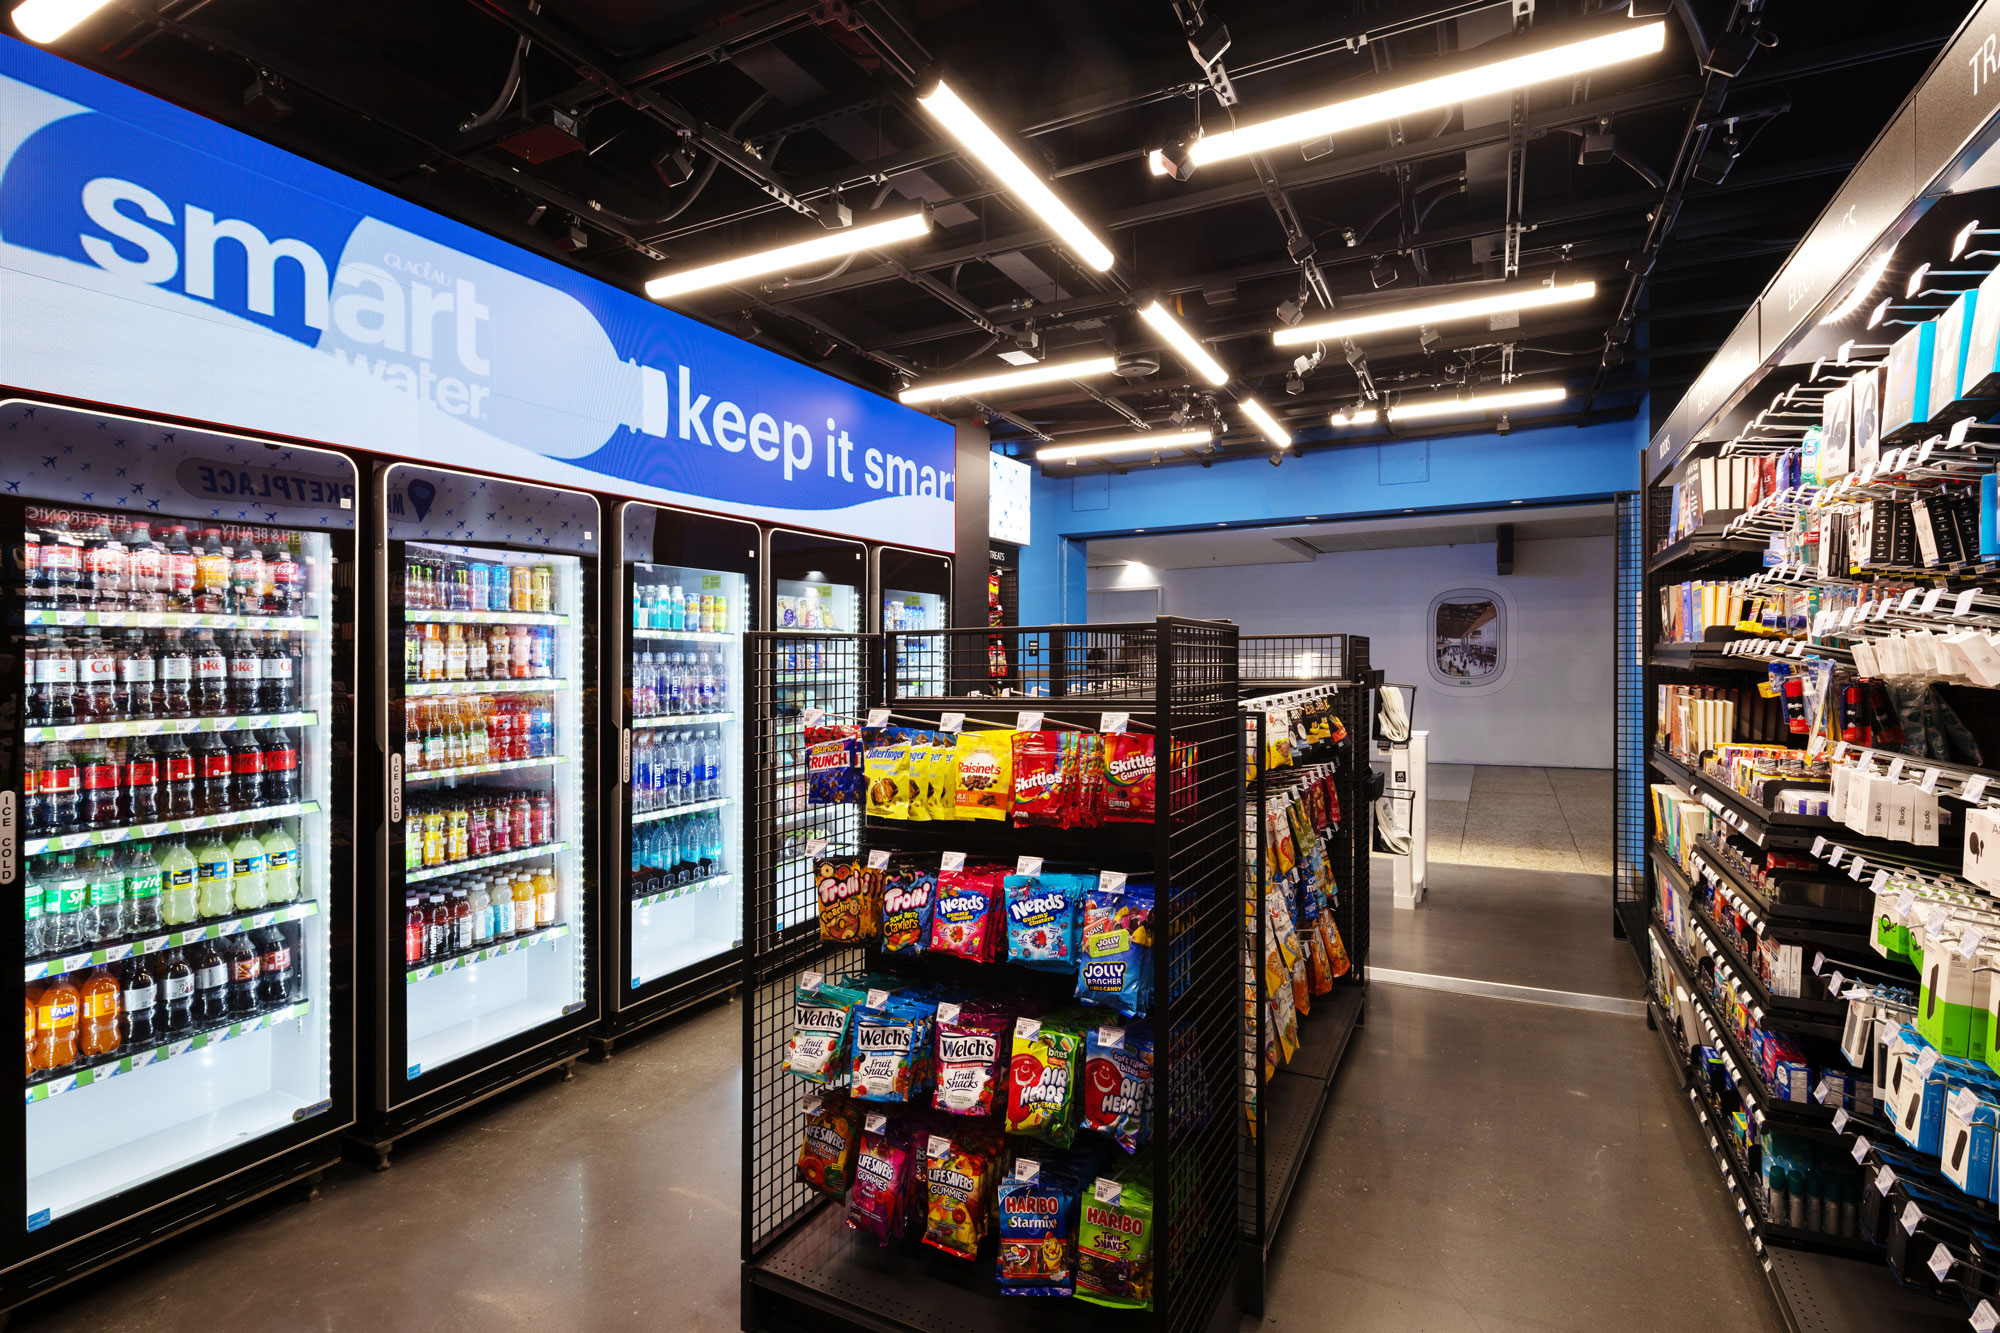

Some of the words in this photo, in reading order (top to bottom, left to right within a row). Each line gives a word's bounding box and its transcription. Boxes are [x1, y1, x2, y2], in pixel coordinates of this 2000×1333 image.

[1969, 33, 2000, 97] TR
[80, 177, 490, 377] smart
[334, 347, 490, 420] water
[679, 364, 813, 481] keep
[826, 417, 854, 482] it
[864, 447, 955, 503] smar
[989, 550, 1005, 561] TREATS
[813, 744, 844, 755] Buncha
[958, 761, 1001, 775] Raisinets
[1015, 771, 1063, 793] Skittles
[2, 796, 11, 827] ICE
[2, 837, 12, 880] COLD
[125, 876, 161, 893] Sprite
[819, 869, 859, 903] Trolli
[884, 882, 931, 913] Trolli
[821, 901, 850, 922] Peachie
[947, 911, 969, 919] Gummy
[1022, 912, 1048, 923] Gummy
[884, 918, 918, 936] Crawlers
[1029, 916, 1055, 926] Clusters
[1085, 924, 1103, 938] JOLLY
[1097, 936, 1120, 948] JOLLY
[1085, 964, 1124, 977] JOLLY
[797, 1010, 843, 1028] Welch's
[804, 1038, 823, 1048] Fruit
[860, 1029, 910, 1046] Welch's
[942, 1040, 994, 1057] Welch's
[1048, 1047, 1068, 1059] bites
[871, 1059, 892, 1069] Fruit
[1114, 1054, 1128, 1064] soft
[1130, 1060, 1149, 1070] filled
[863, 1066, 894, 1077] Snacks
[953, 1071, 975, 1080] Fruit
[1040, 1066, 1067, 1087] AIR
[1121, 1065, 1138, 1077] bites
[946, 1079, 978, 1089] Snacks
[1120, 1078, 1146, 1100] AIR
[1020, 1085, 1065, 1107] HEADS
[1102, 1094, 1142, 1115] HEADS
[1028, 1102, 1062, 1112] XTREMES
[822, 1142, 840, 1158] CANDY
[857, 1170, 888, 1192] GUMMIES
[928, 1168, 946, 1184] LIFE
[946, 1171, 974, 1191] SAVERS
[930, 1185, 968, 1203] GUMMIES
[1005, 1196, 1059, 1214] HARIBO
[1010, 1215, 1055, 1229] Starmix
[1086, 1206, 1143, 1236] HARIBO
[1093, 1235, 1131, 1253] SNAKES
[1102, 1231, 1121, 1241] TWIN
